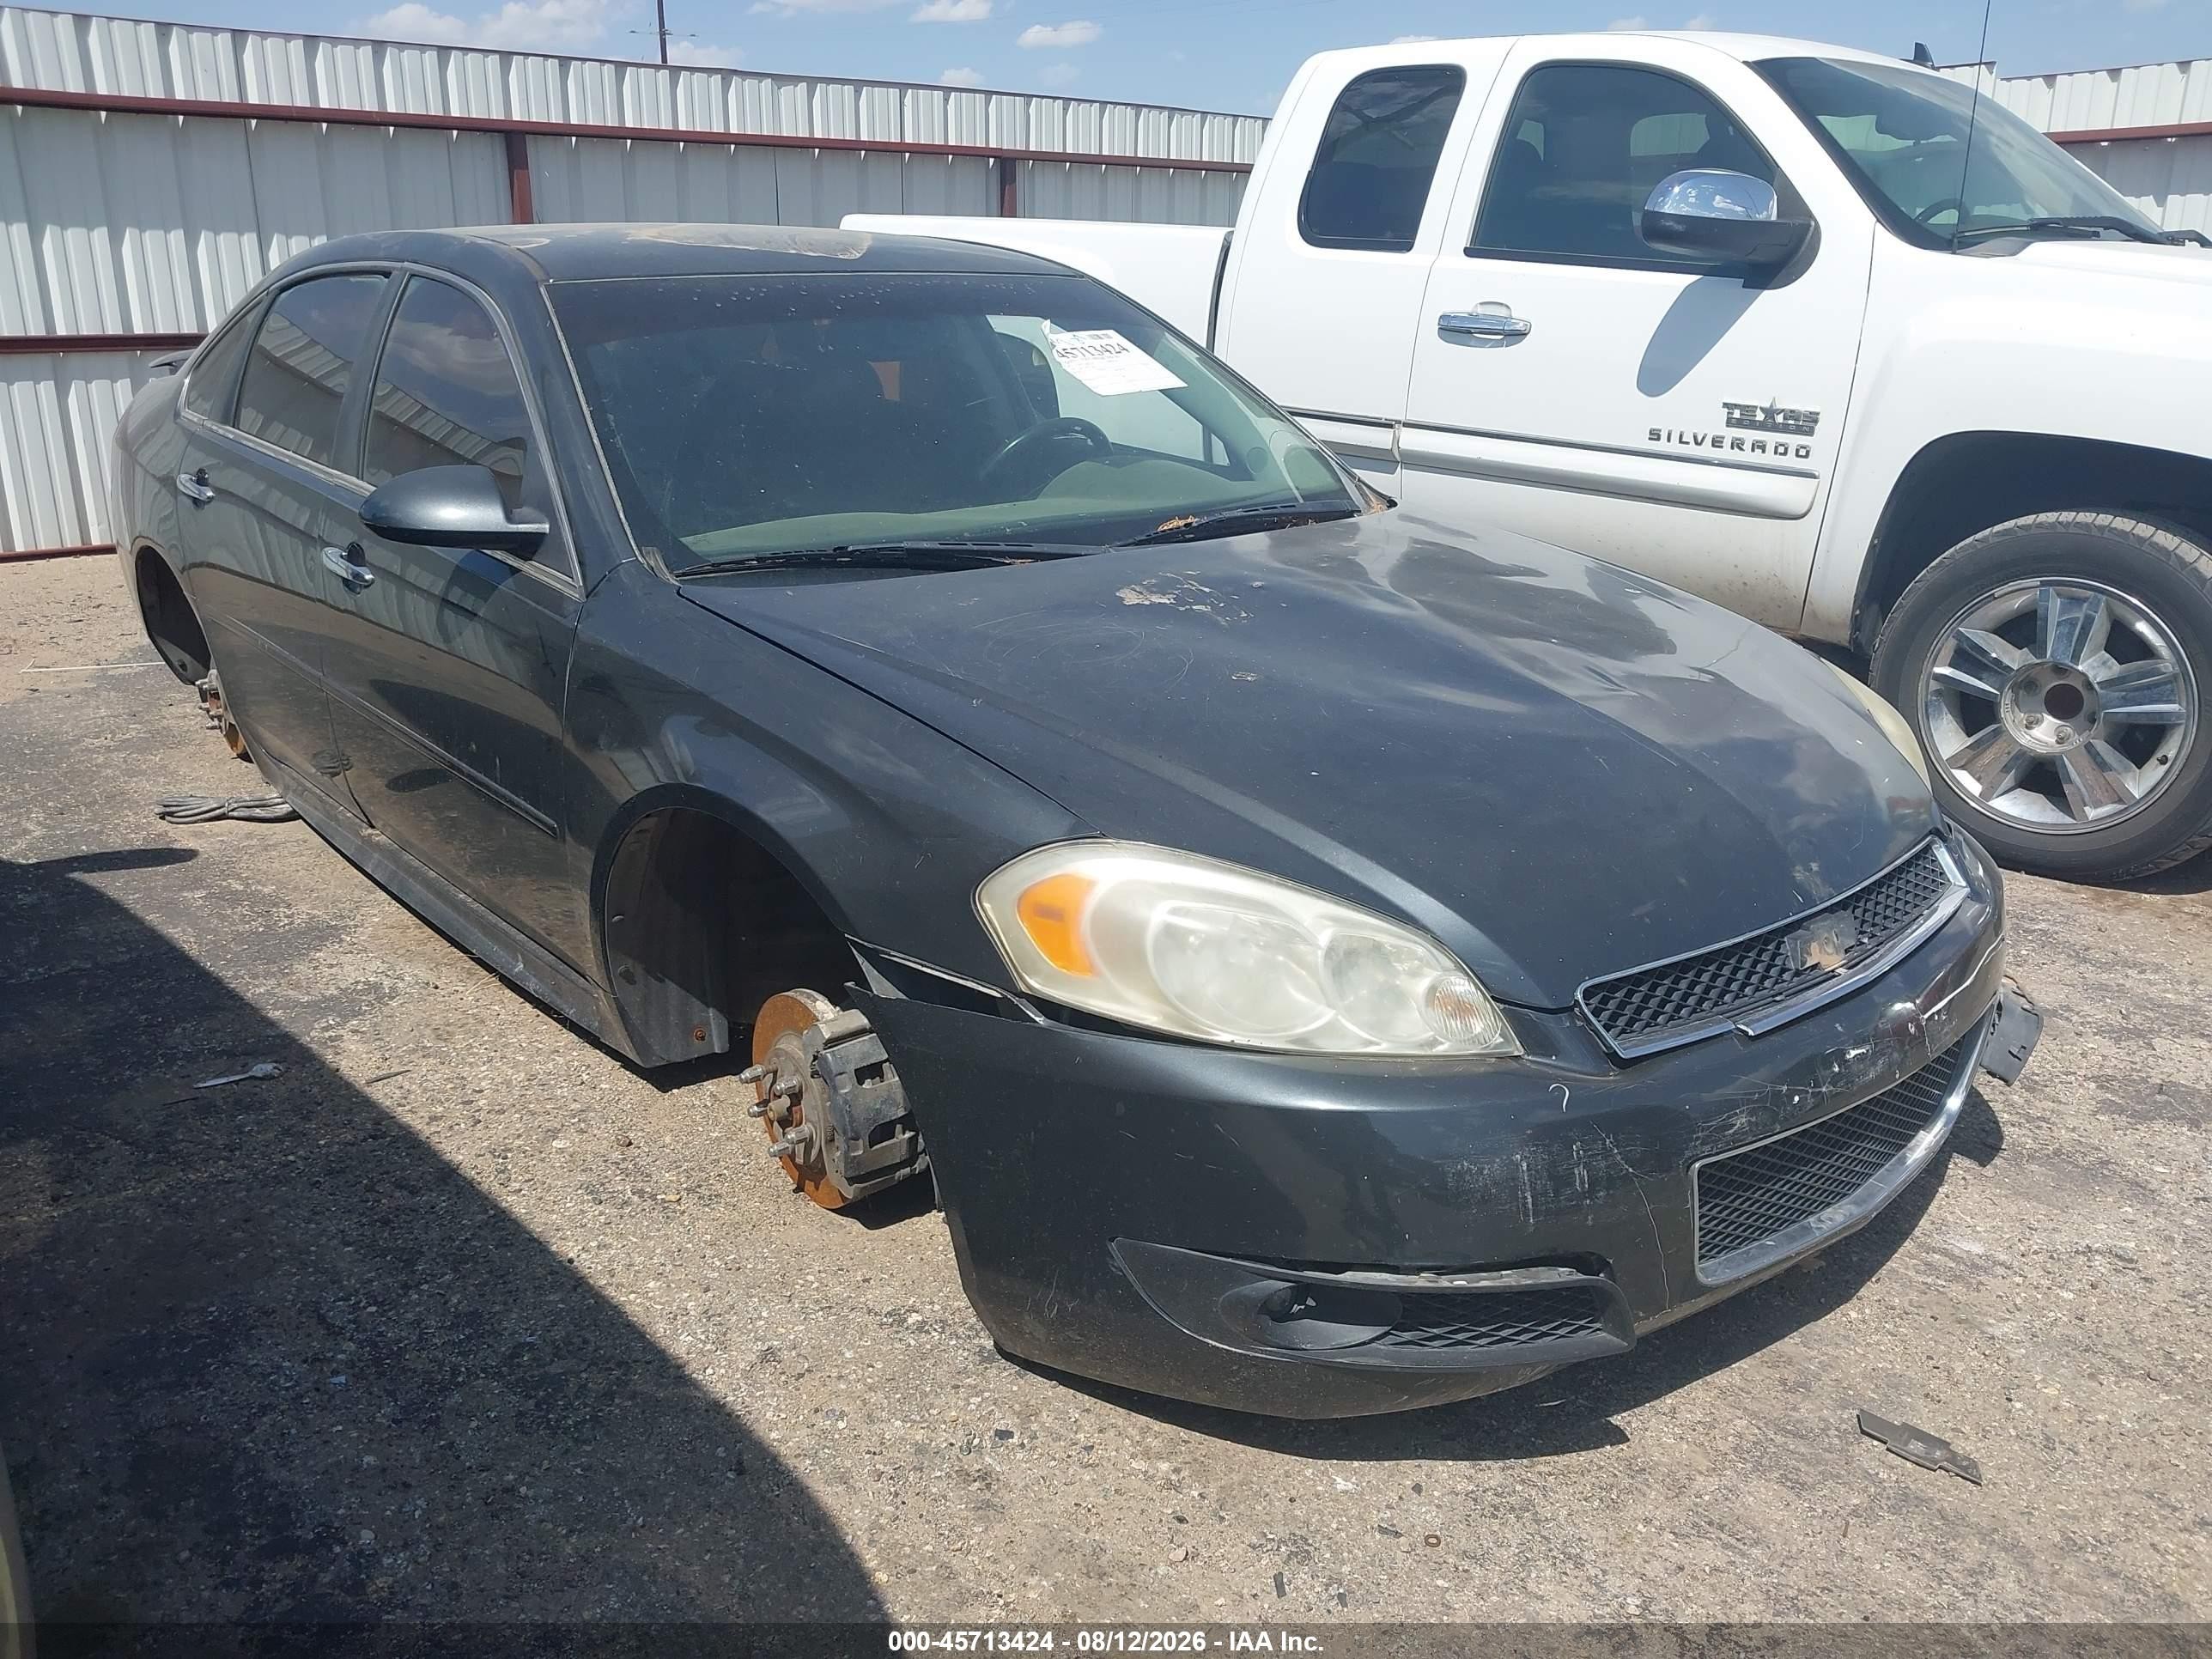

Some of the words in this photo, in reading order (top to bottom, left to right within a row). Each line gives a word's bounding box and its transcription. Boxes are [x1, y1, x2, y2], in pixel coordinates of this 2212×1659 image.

[1055, 343, 1130, 359] 45713424
[1722, 398, 1820, 426] TEXAS
[1648, 428, 1812, 459] SILVERADO
